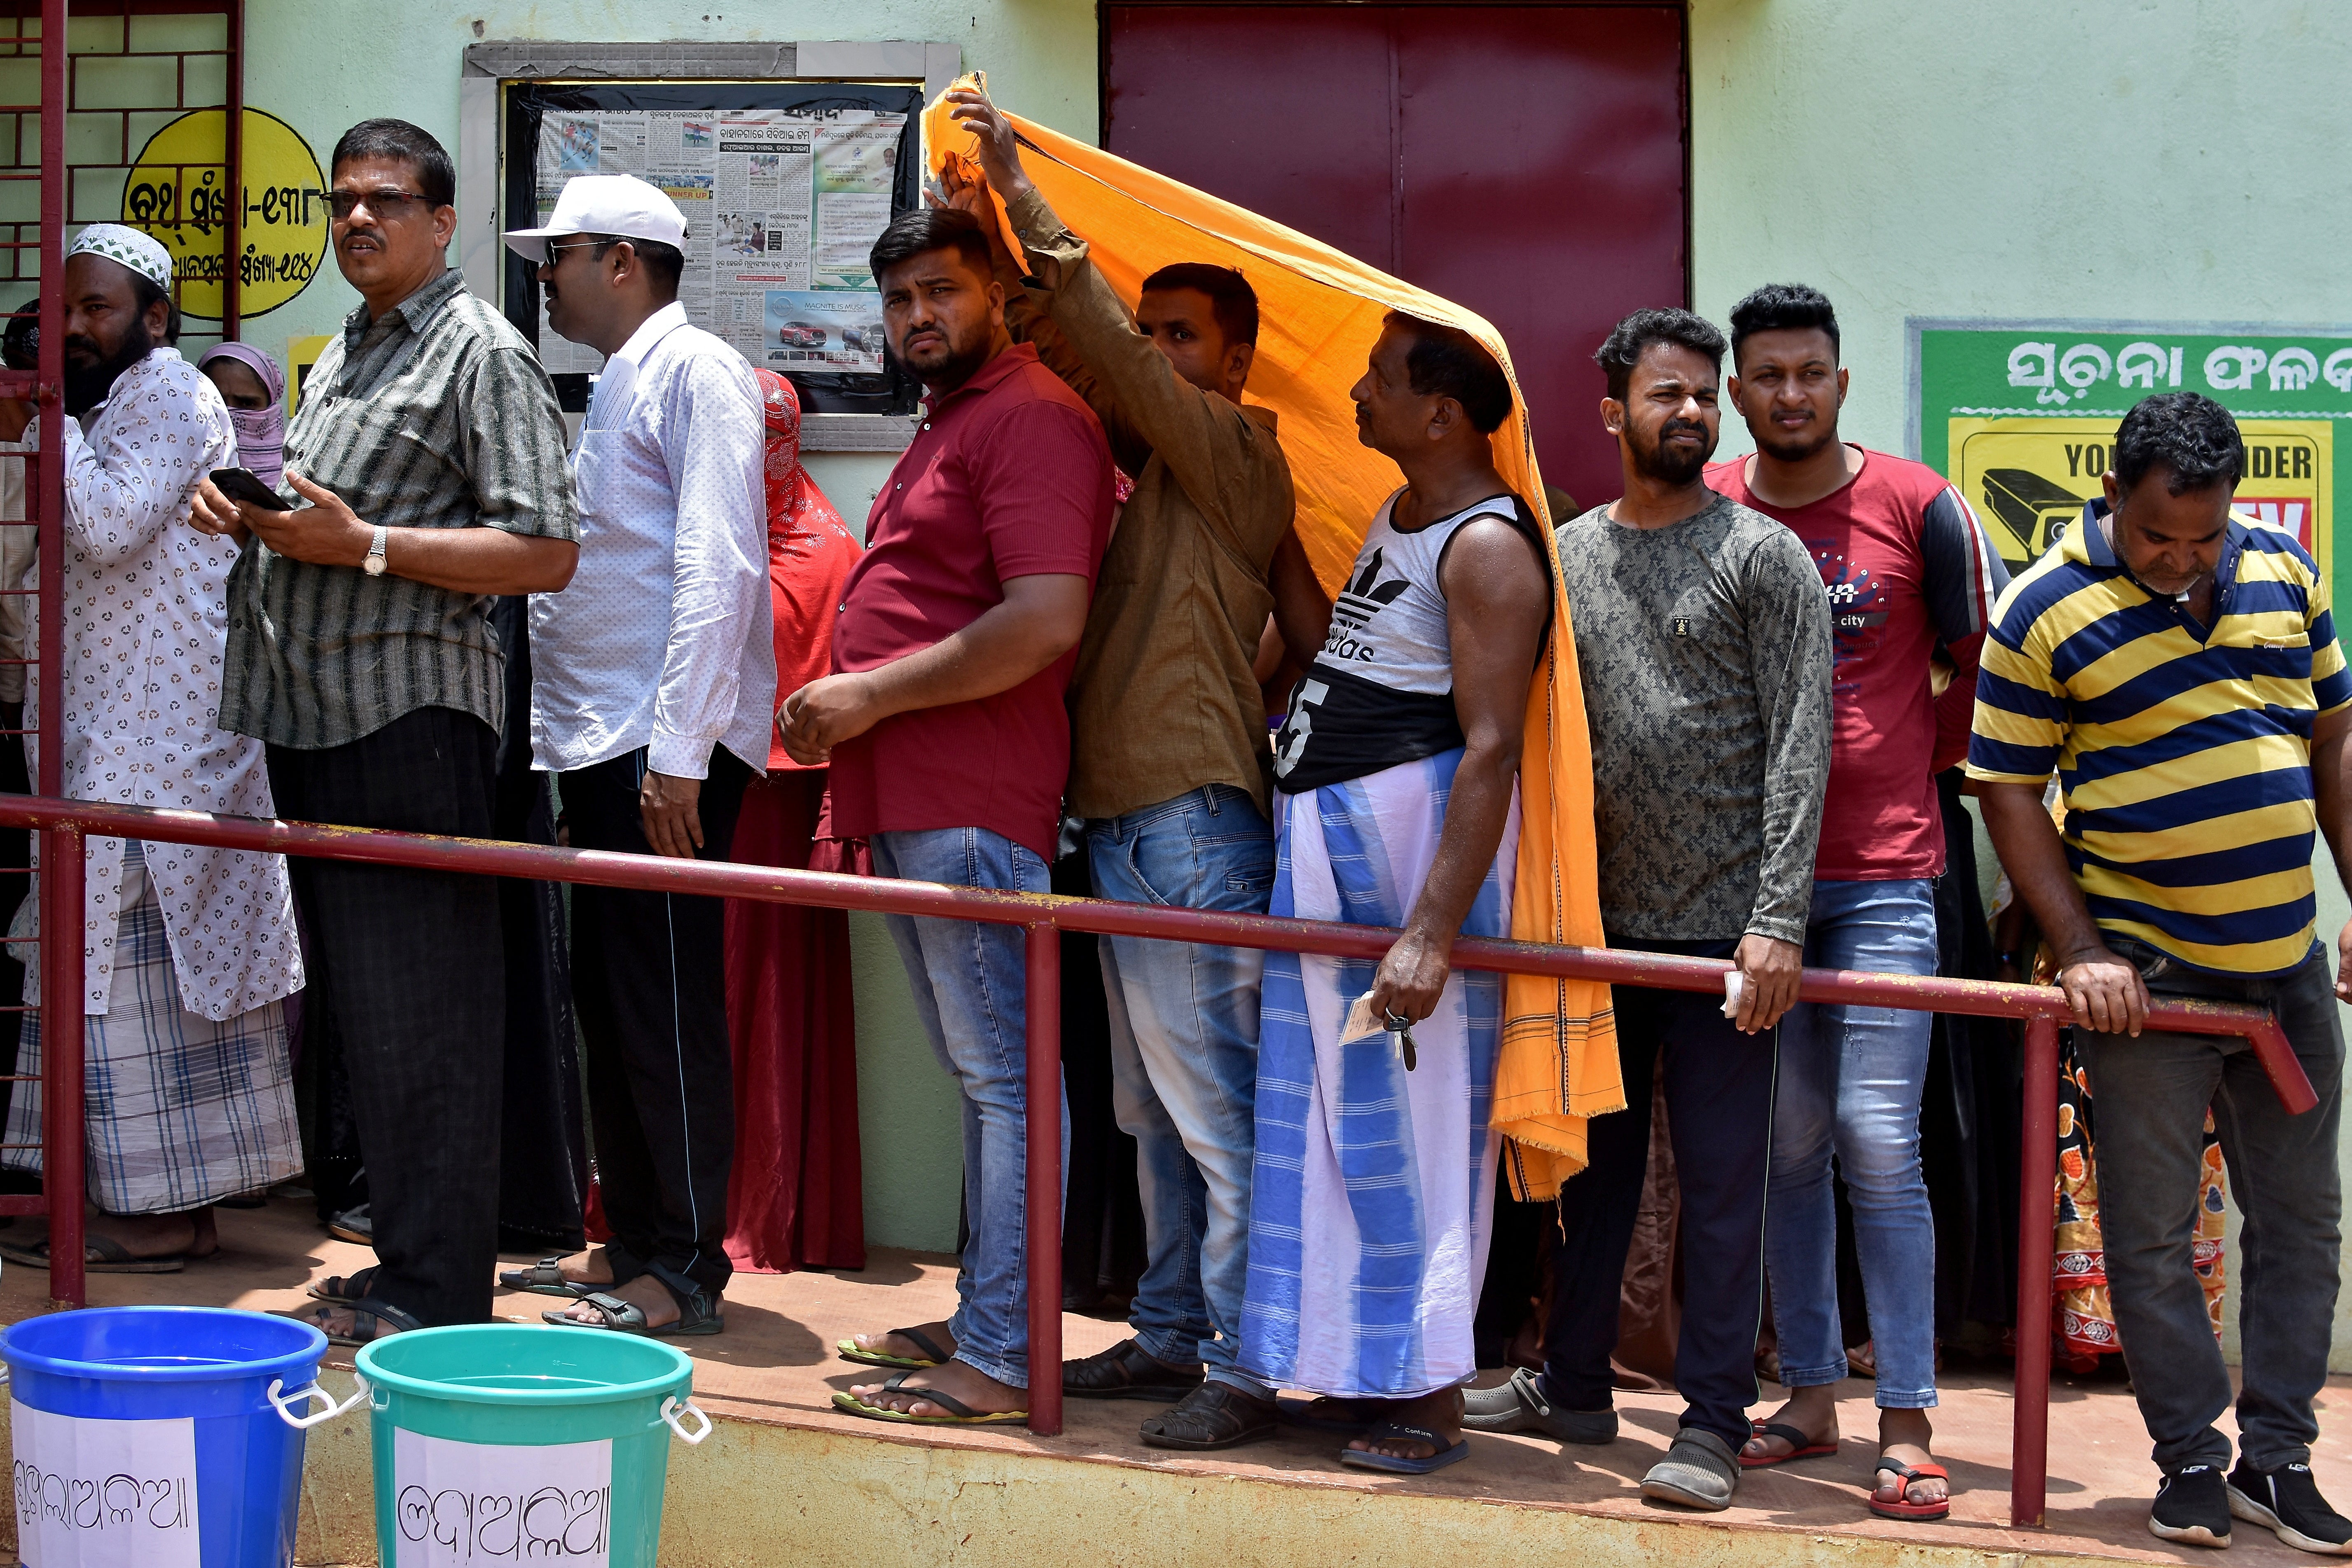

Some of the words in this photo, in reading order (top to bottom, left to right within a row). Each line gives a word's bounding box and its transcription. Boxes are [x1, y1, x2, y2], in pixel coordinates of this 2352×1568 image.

[720, 129, 764, 138] ବାହାନଗାରେ
[767, 128, 794, 139] ସିବିଆଇ
[2242, 446, 2311, 479] DER
[1841, 615, 1865, 627] city
